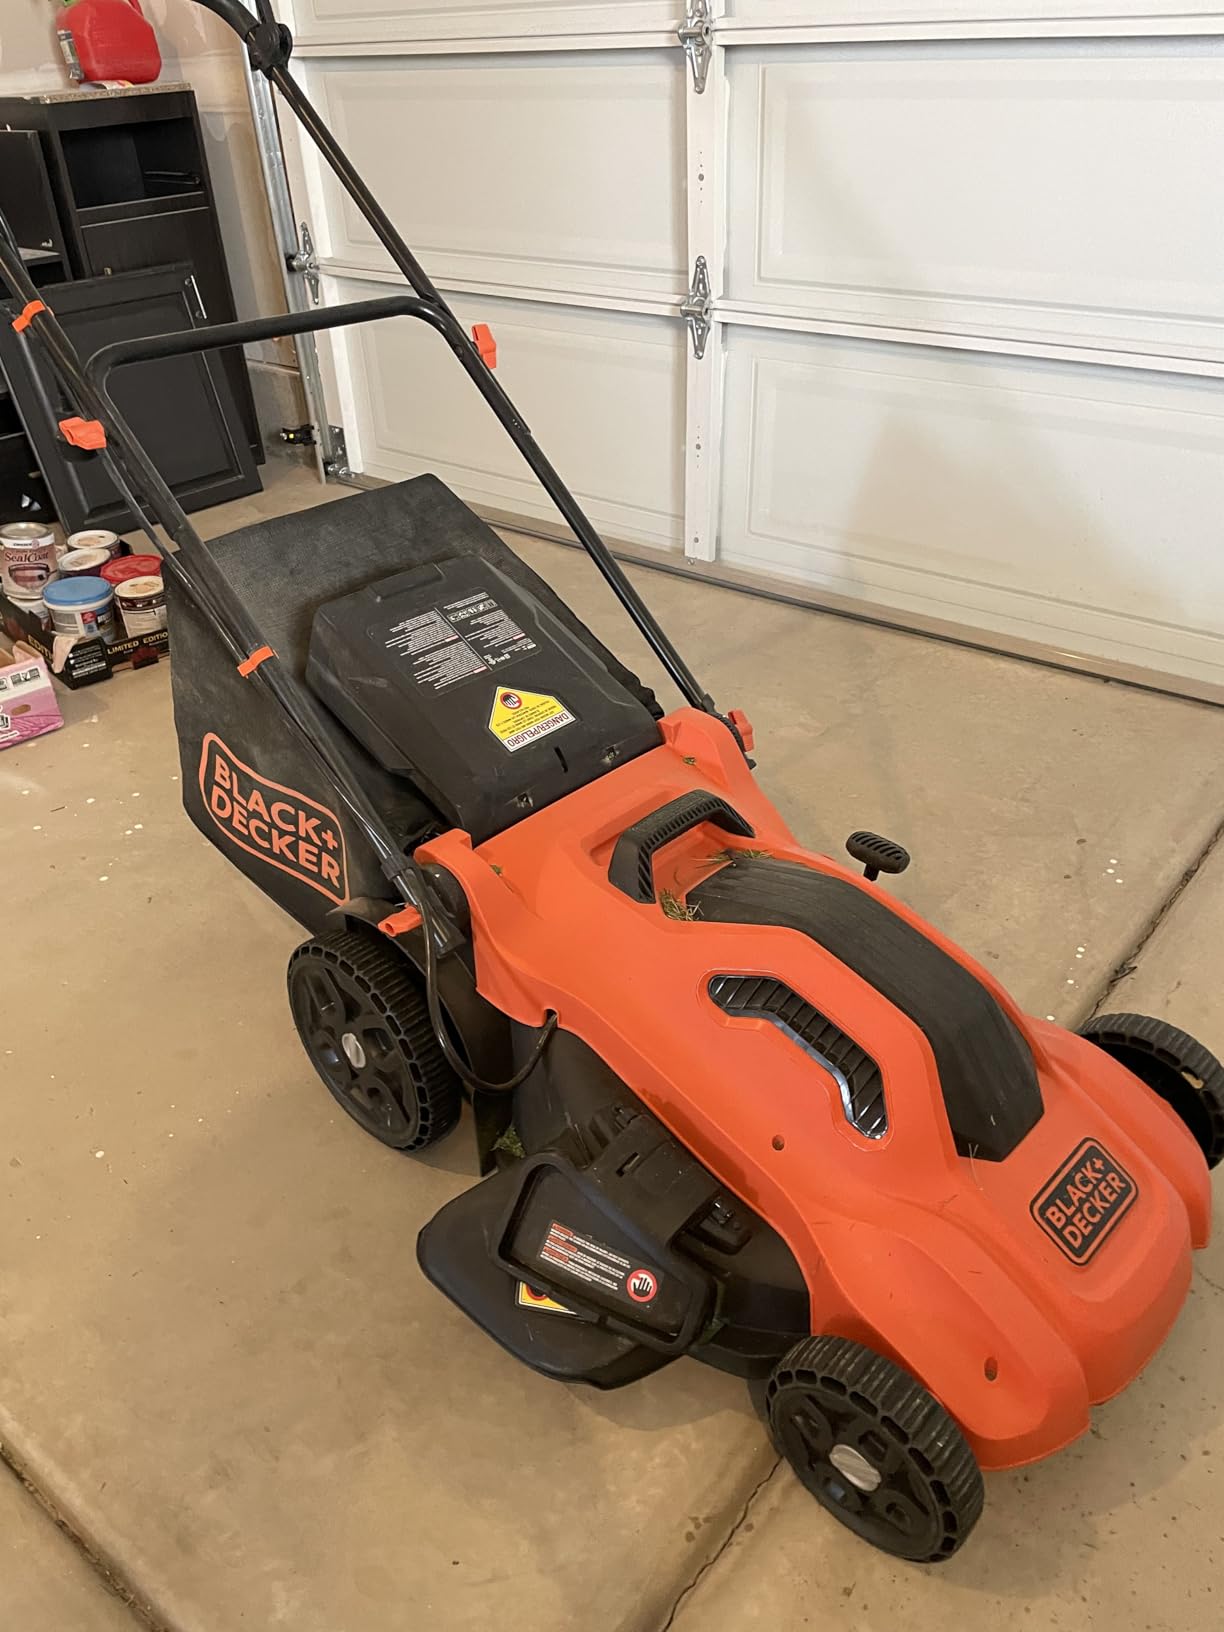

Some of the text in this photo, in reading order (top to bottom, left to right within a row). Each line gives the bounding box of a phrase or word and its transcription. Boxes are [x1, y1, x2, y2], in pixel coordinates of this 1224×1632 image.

[107, 640, 139, 655] LIMITED
[143, 631, 168, 644] EDITIO
[507, 712, 569, 747] DANGER/PELIGRO
[211, 785, 340, 889] DECKER
[214, 753, 338, 850] BLACK+
[1062, 1172, 1127, 1249] DECKER
